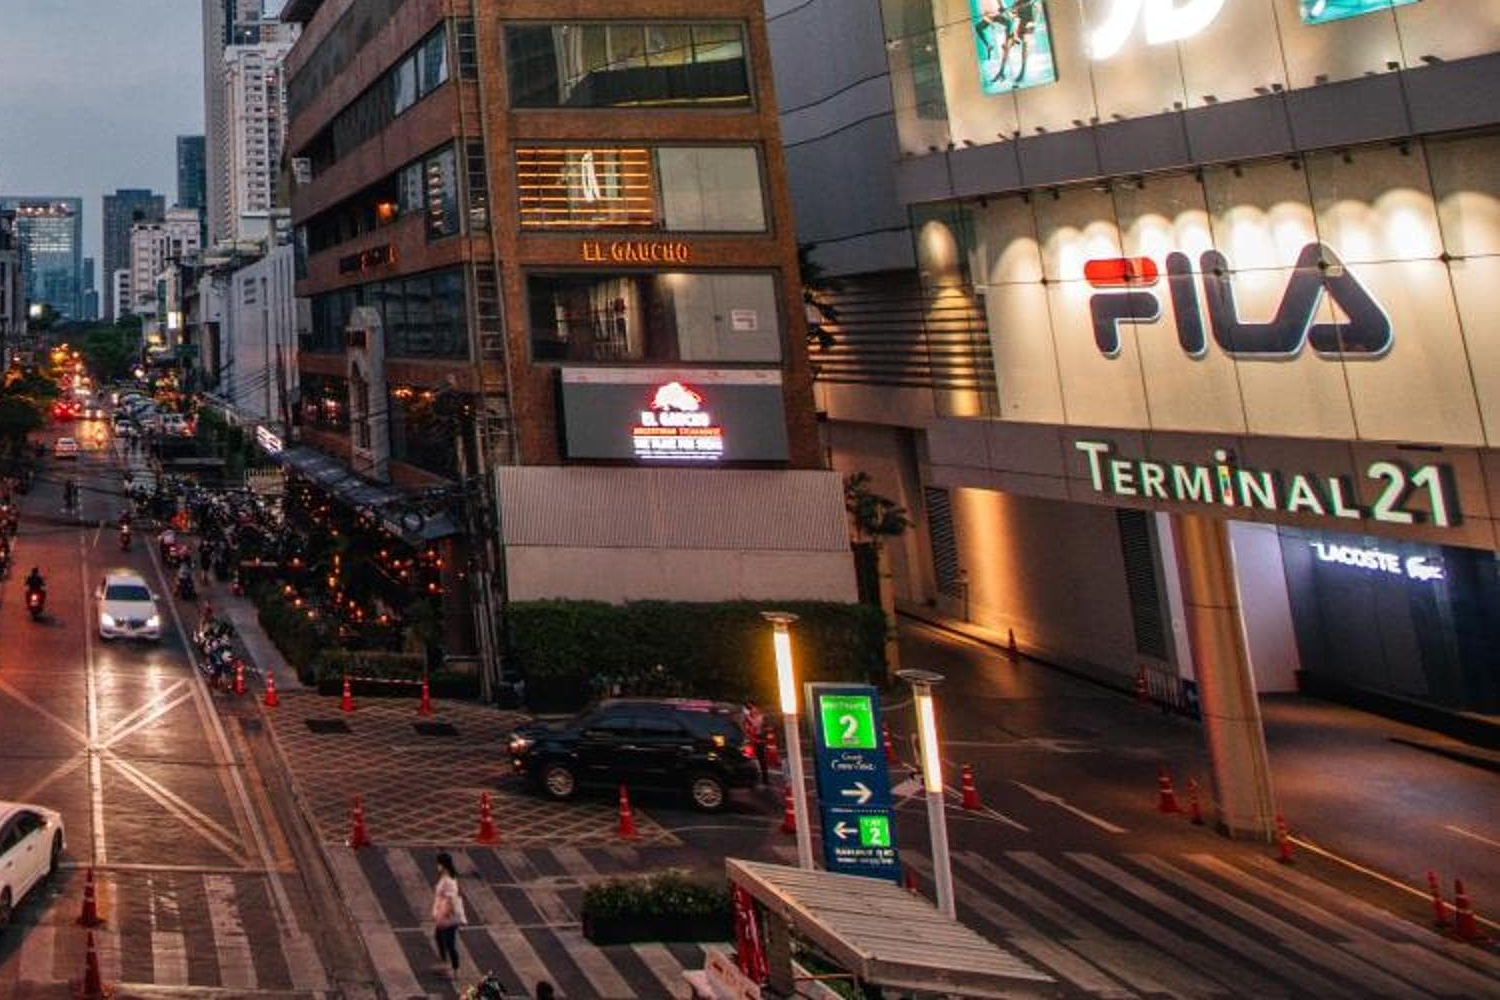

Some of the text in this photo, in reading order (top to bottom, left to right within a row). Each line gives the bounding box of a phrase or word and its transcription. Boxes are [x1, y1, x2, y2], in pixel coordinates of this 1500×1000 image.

[582, 240, 692, 263] EL GAUCHO
[1083, 242, 1394, 359] FILA
[1367, 461, 1450, 528] 21
[1311, 543, 1403, 575] LACOSTE
[839, 714, 860, 744] 2
